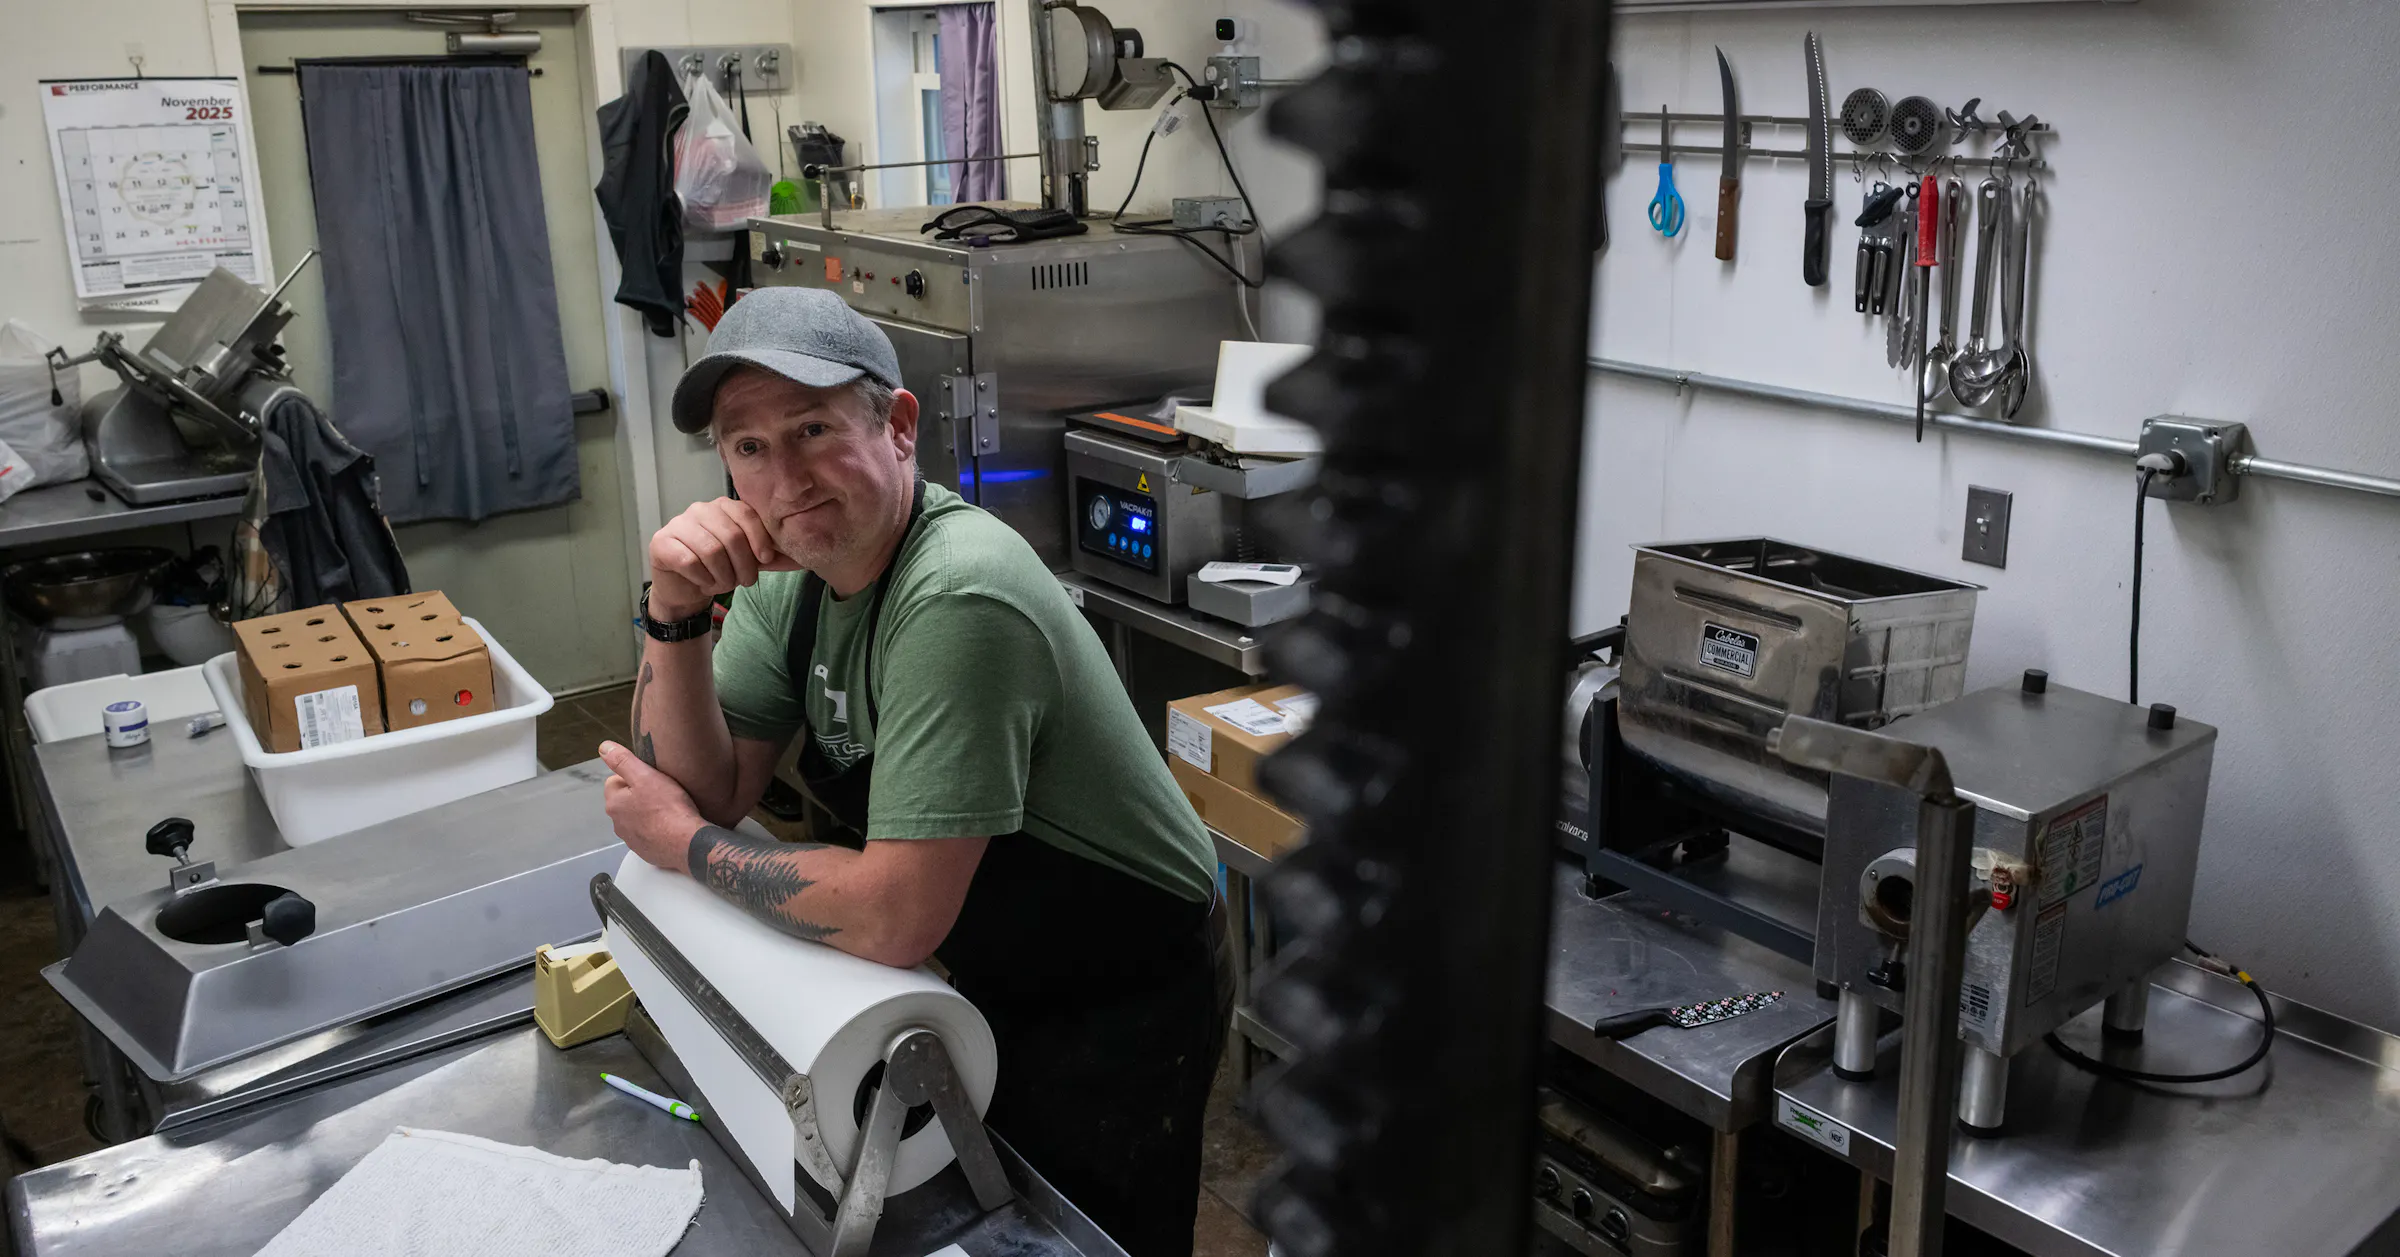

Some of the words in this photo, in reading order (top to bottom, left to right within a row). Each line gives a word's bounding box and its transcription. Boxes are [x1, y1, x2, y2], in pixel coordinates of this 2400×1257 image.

[69, 82, 139, 92] PERFORMANCE
[161, 97, 232, 107] November
[185, 107, 233, 120] 2025
[108, 181, 118, 189] 10
[132, 180, 142, 188] 11
[157, 179, 167, 187] 12
[230, 176, 240, 184] 15
[86, 208, 96, 216] 16
[160, 203, 171, 211] 19
[184, 202, 194, 210] 20
[208, 201, 218, 209] 21
[233, 200, 243, 208] 22
[116, 231, 126, 239] 24
[212, 225, 222, 233] 28
[236, 224, 247, 232] 29
[1706, 643, 1749, 665] COMMERCIAL
[1831, 1132, 1843, 1144] NSF
